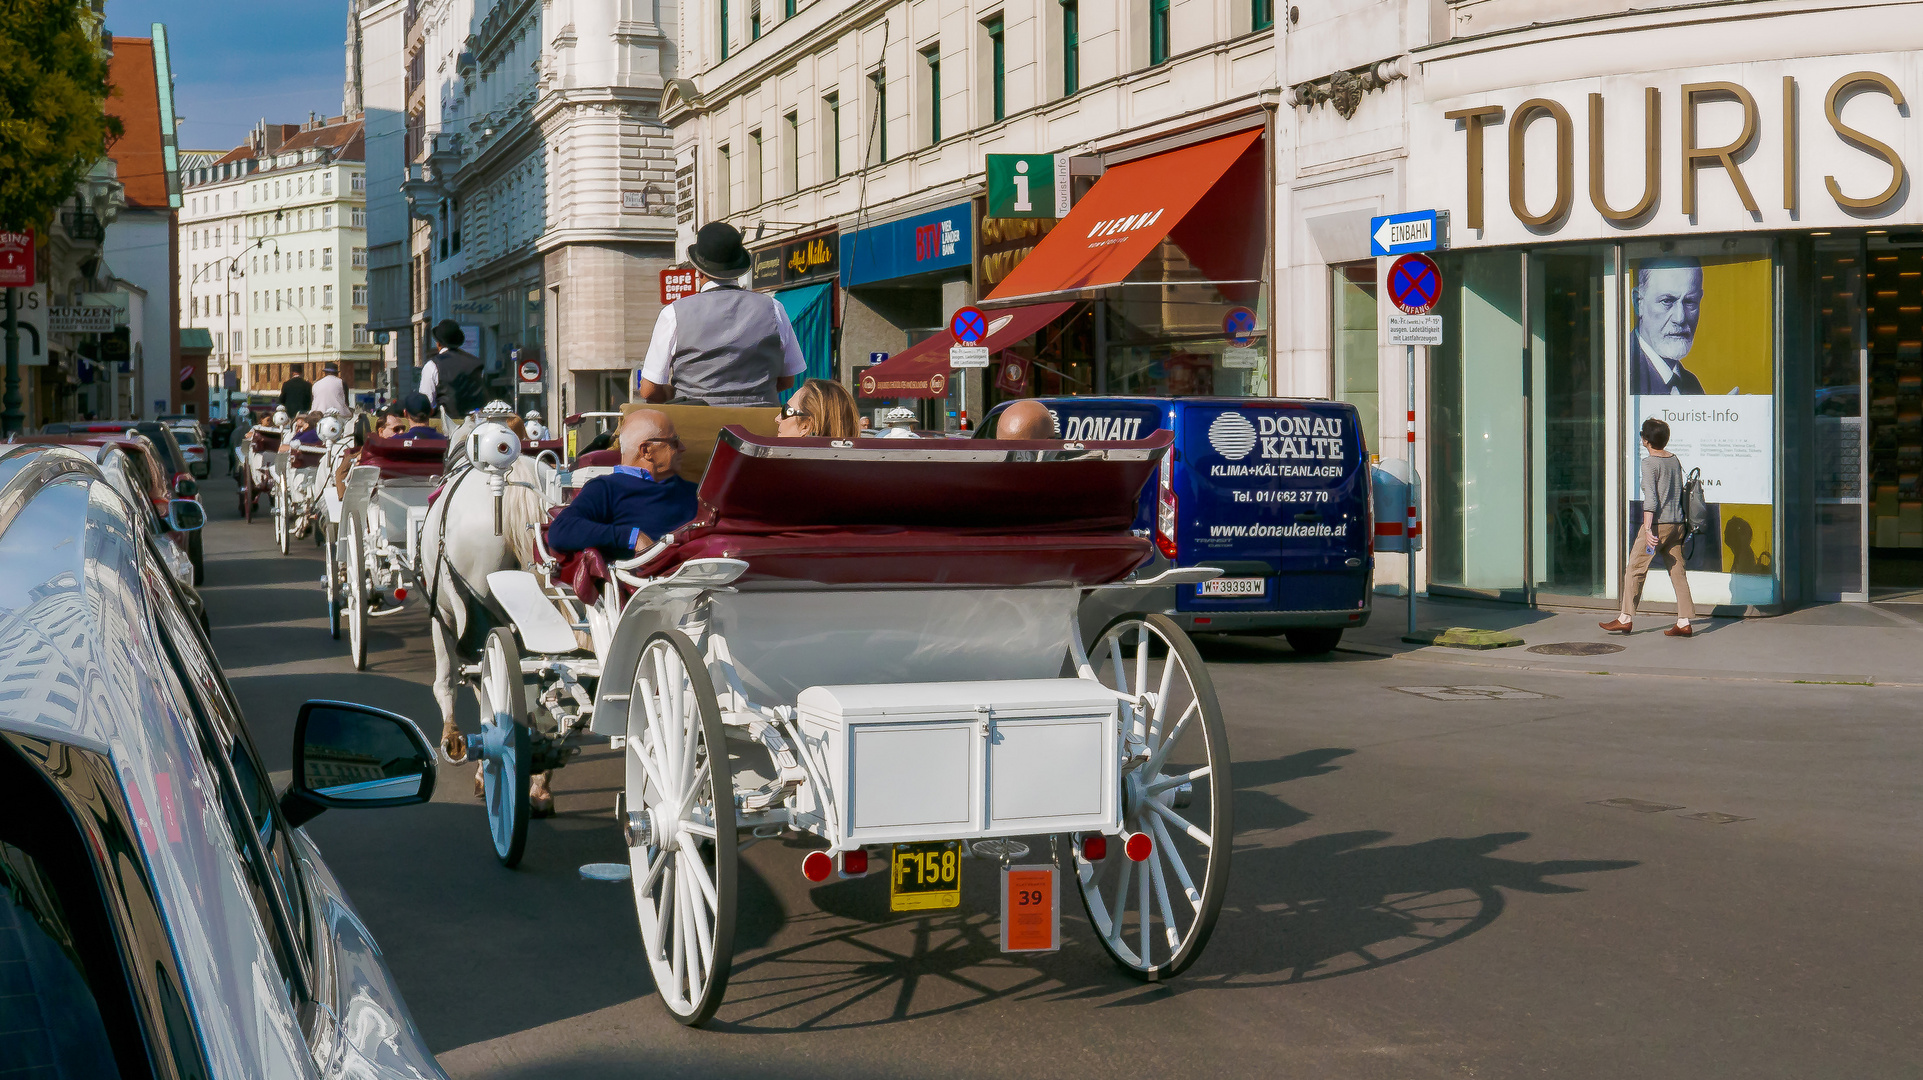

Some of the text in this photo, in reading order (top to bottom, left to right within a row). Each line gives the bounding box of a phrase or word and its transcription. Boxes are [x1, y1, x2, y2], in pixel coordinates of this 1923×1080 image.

[1444, 71, 1905, 230] TOURIS
[1058, 157, 1068, 214] Tourist-Info
[941, 219, 952, 232] VIER
[1086, 207, 1165, 239] VIENNA
[942, 229, 960, 244] LÄNDER
[1391, 222, 1428, 242] EINBAHN
[916, 222, 942, 262] BTV
[942, 242, 955, 256] BANK
[799, 239, 832, 273] Müller
[665, 272, 692, 285] Café
[665, 284, 692, 293] Coffee
[665, 292, 682, 300] Day
[1399, 303, 1430, 314] ANFANG
[1661, 408, 1739, 422] Tourist-Info
[1257, 416, 1342, 437] DONAU
[1260, 436, 1344, 459] KÄLTE
[1210, 463, 1343, 477] KLIMA+KÄLTEANLAGEN
[1233, 490, 1253, 502] Tel.
[1299, 491, 1312, 502] 37
[1316, 491, 1328, 502] 70
[1210, 522, 1347, 537] www.donaukaelte.at
[897, 850, 956, 885] F158
[1018, 890, 1042, 906] 39
